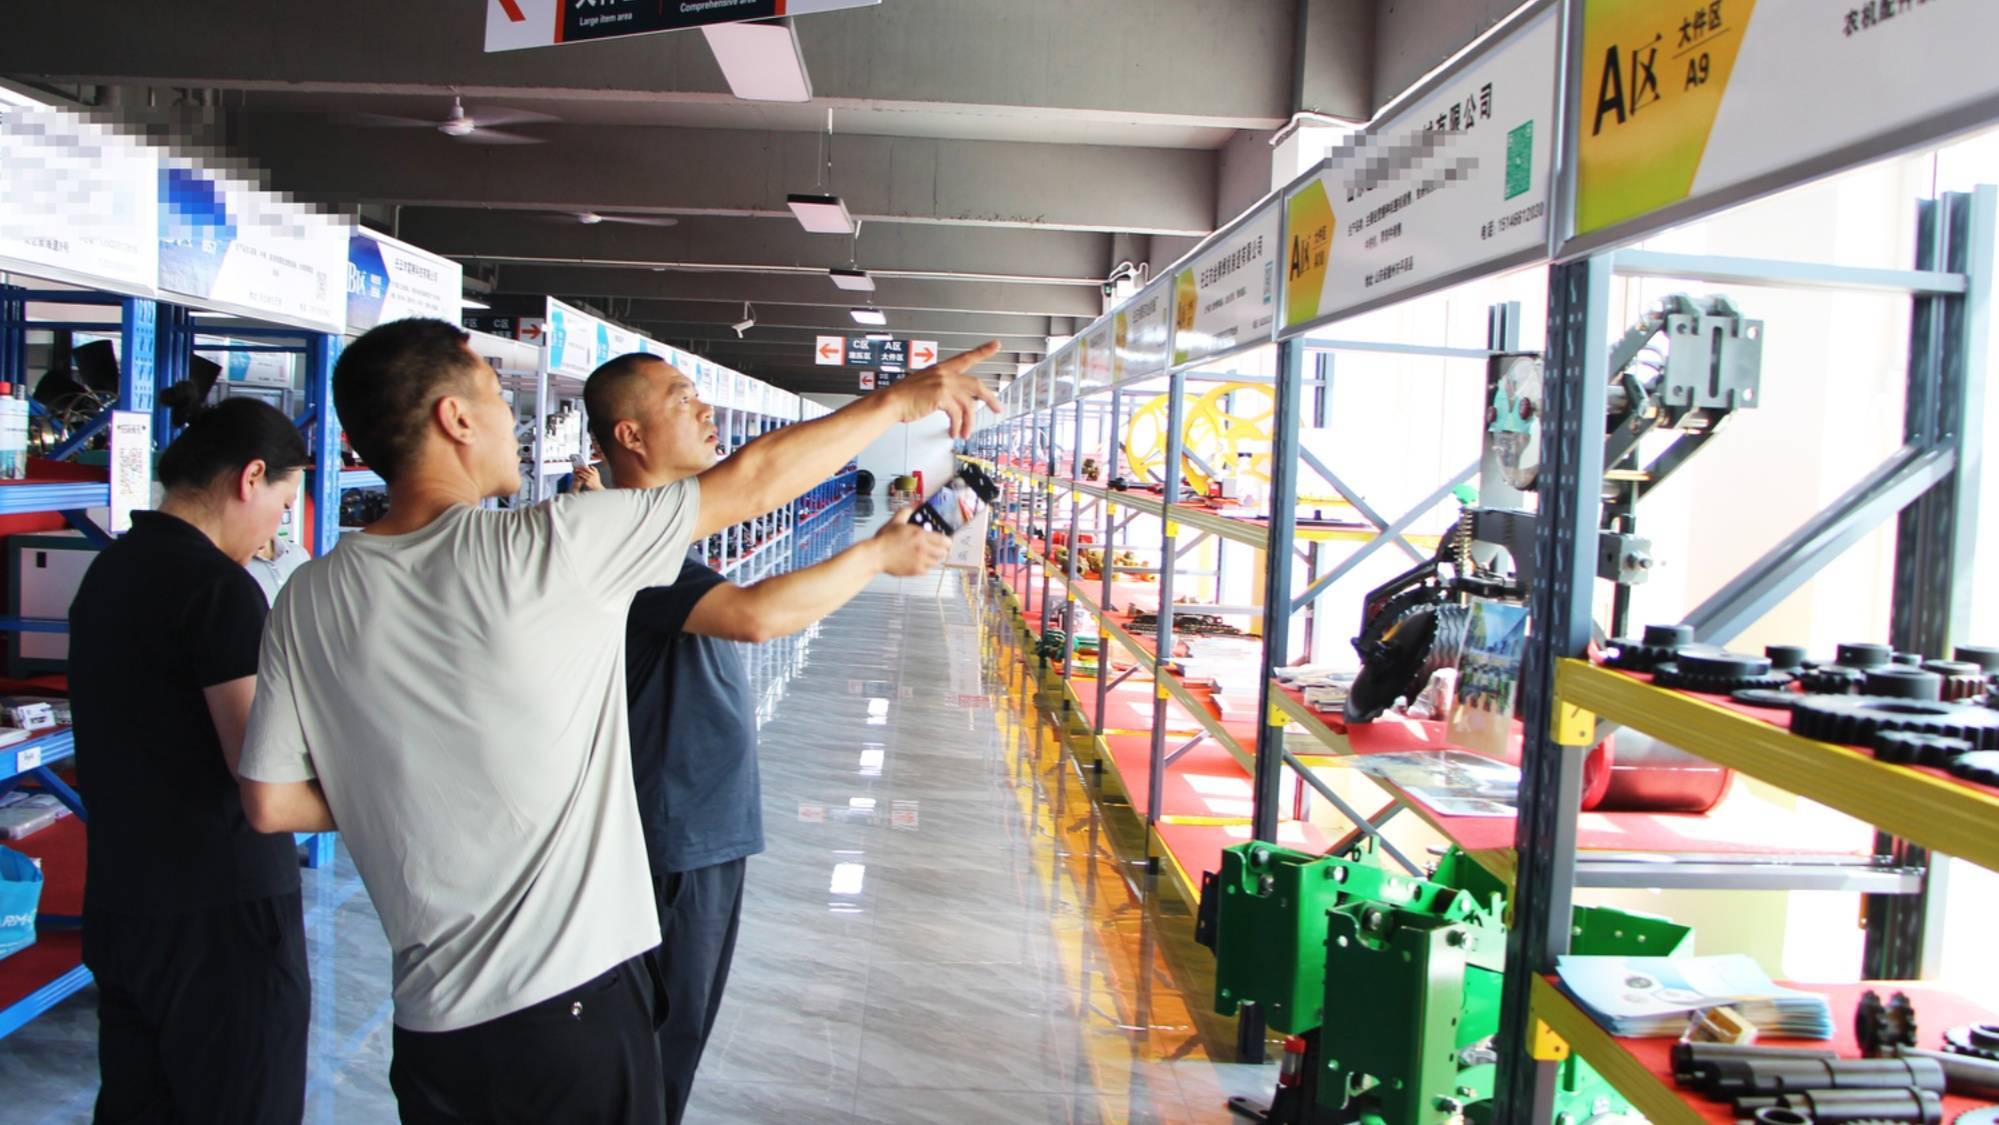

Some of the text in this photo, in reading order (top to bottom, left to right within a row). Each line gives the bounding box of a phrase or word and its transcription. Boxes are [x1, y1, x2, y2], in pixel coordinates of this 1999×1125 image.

[579, 13, 632, 27] Large item area
[680, 0, 737, 13] Comprehensive
[1676, 0, 1723, 48] 大件区
[1592, 33, 1663, 137] A区
[1684, 52, 1709, 92] A9
[853, 340, 902, 351] C区 A区
